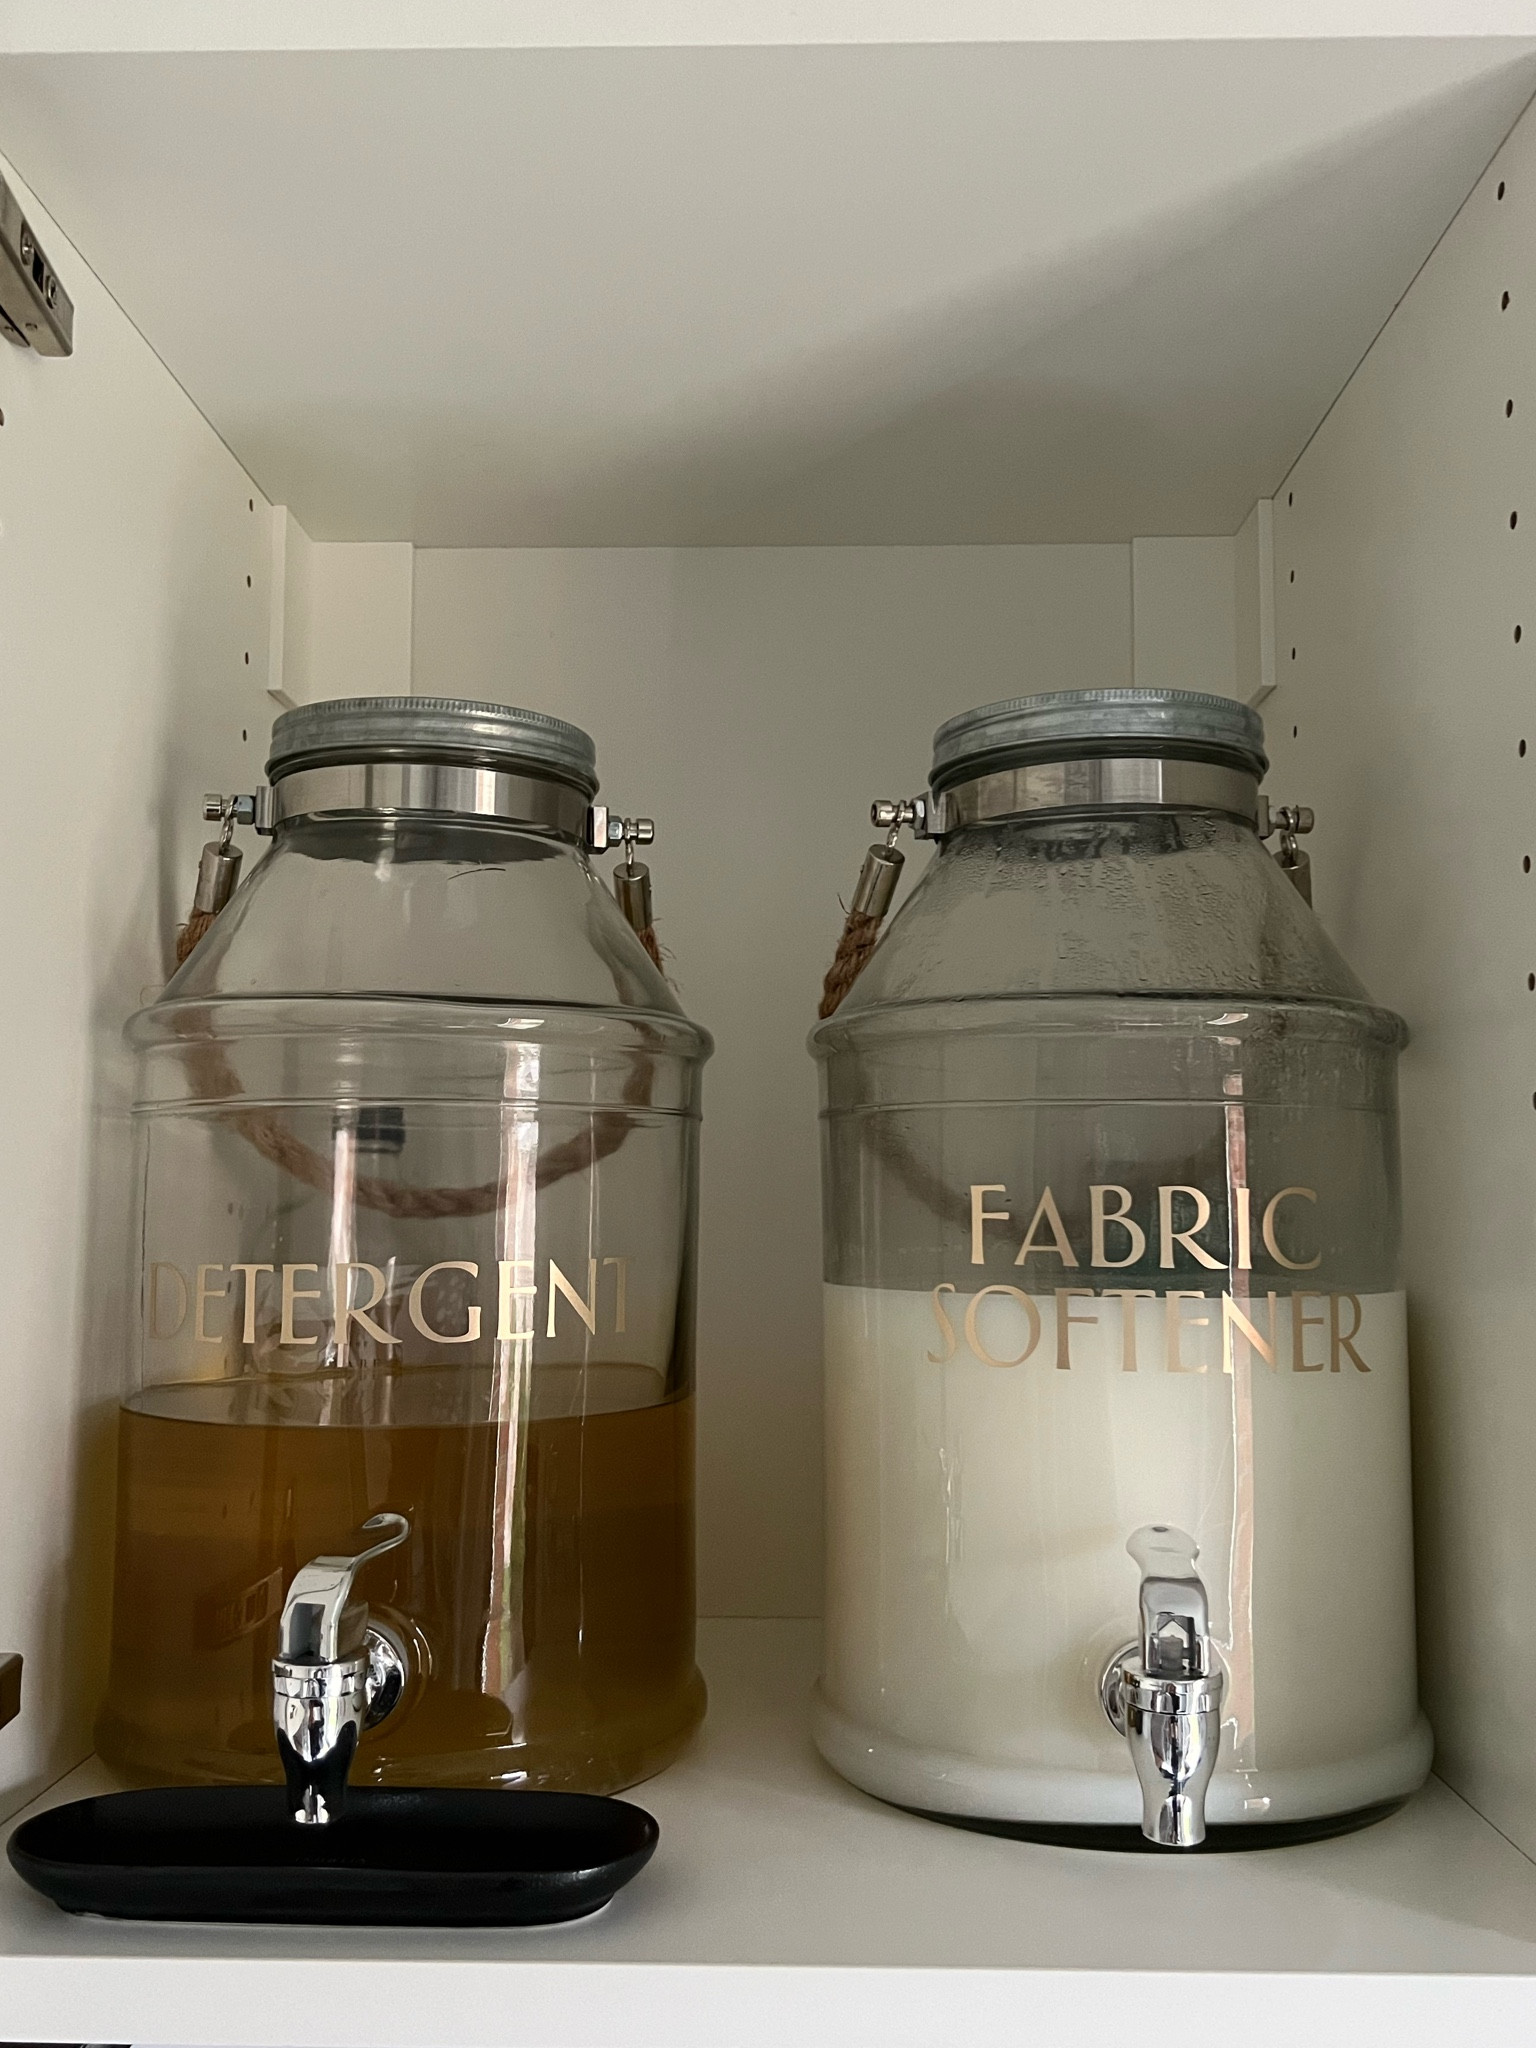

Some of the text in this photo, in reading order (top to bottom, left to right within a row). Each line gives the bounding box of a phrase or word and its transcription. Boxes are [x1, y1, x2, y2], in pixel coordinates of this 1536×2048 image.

[969, 1184, 1322, 1270] FABRIC
[149, 1257, 633, 1344] DETERGENT
[927, 1283, 1372, 1374] SOFTENER
